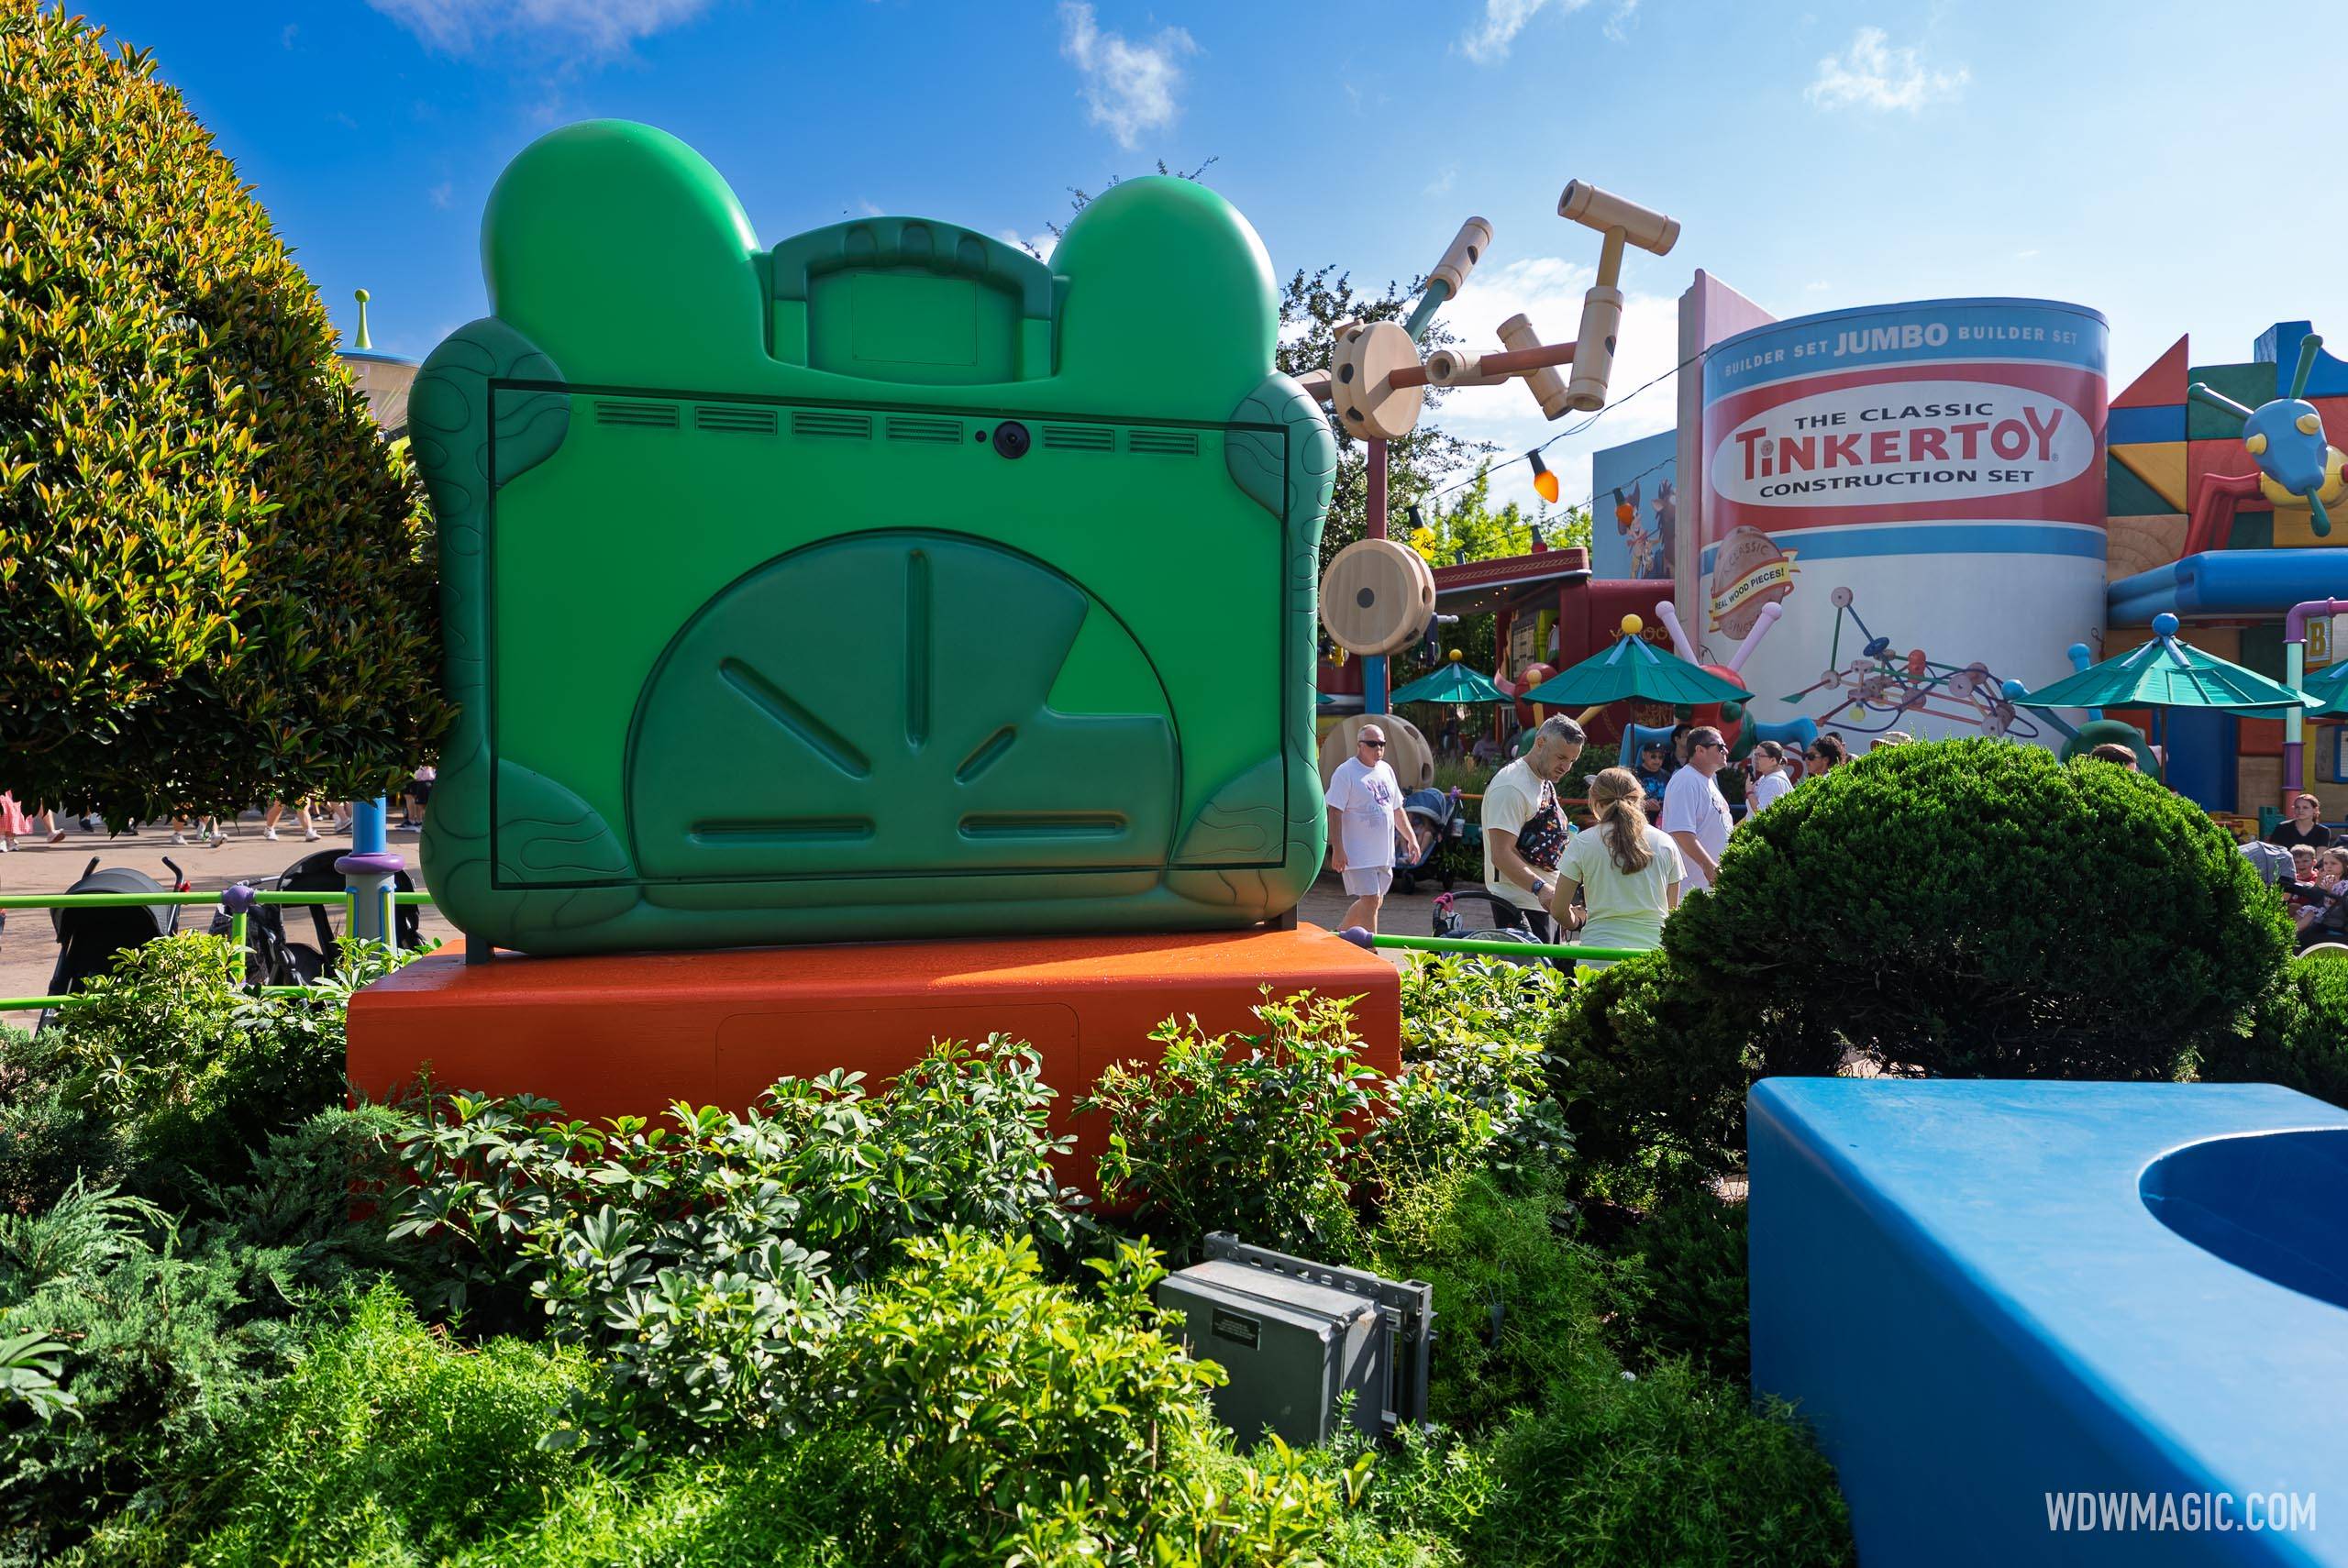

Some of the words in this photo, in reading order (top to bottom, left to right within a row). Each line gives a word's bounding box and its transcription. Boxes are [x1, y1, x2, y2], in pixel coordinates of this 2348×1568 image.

[1725, 348, 1785, 377] BUILDER
[1793, 341, 1828, 359] SET
[1833, 322, 1949, 358] JUMBO
[1958, 326, 2044, 341] BUILDER
[2052, 329, 2077, 346] SET
[1794, 412, 1847, 431] THE
[1859, 403, 1994, 422] CLASSIC
[1759, 469, 1977, 498] CONSTRUCTION
[1988, 469, 2034, 483] SET
[1728, 542, 1769, 566] CLASSIC
[1714, 600, 1728, 611] REAL
[1728, 583, 1749, 603] WOOD
[1750, 568, 1785, 588] PIECES!
[2309, 622, 2326, 657] B
